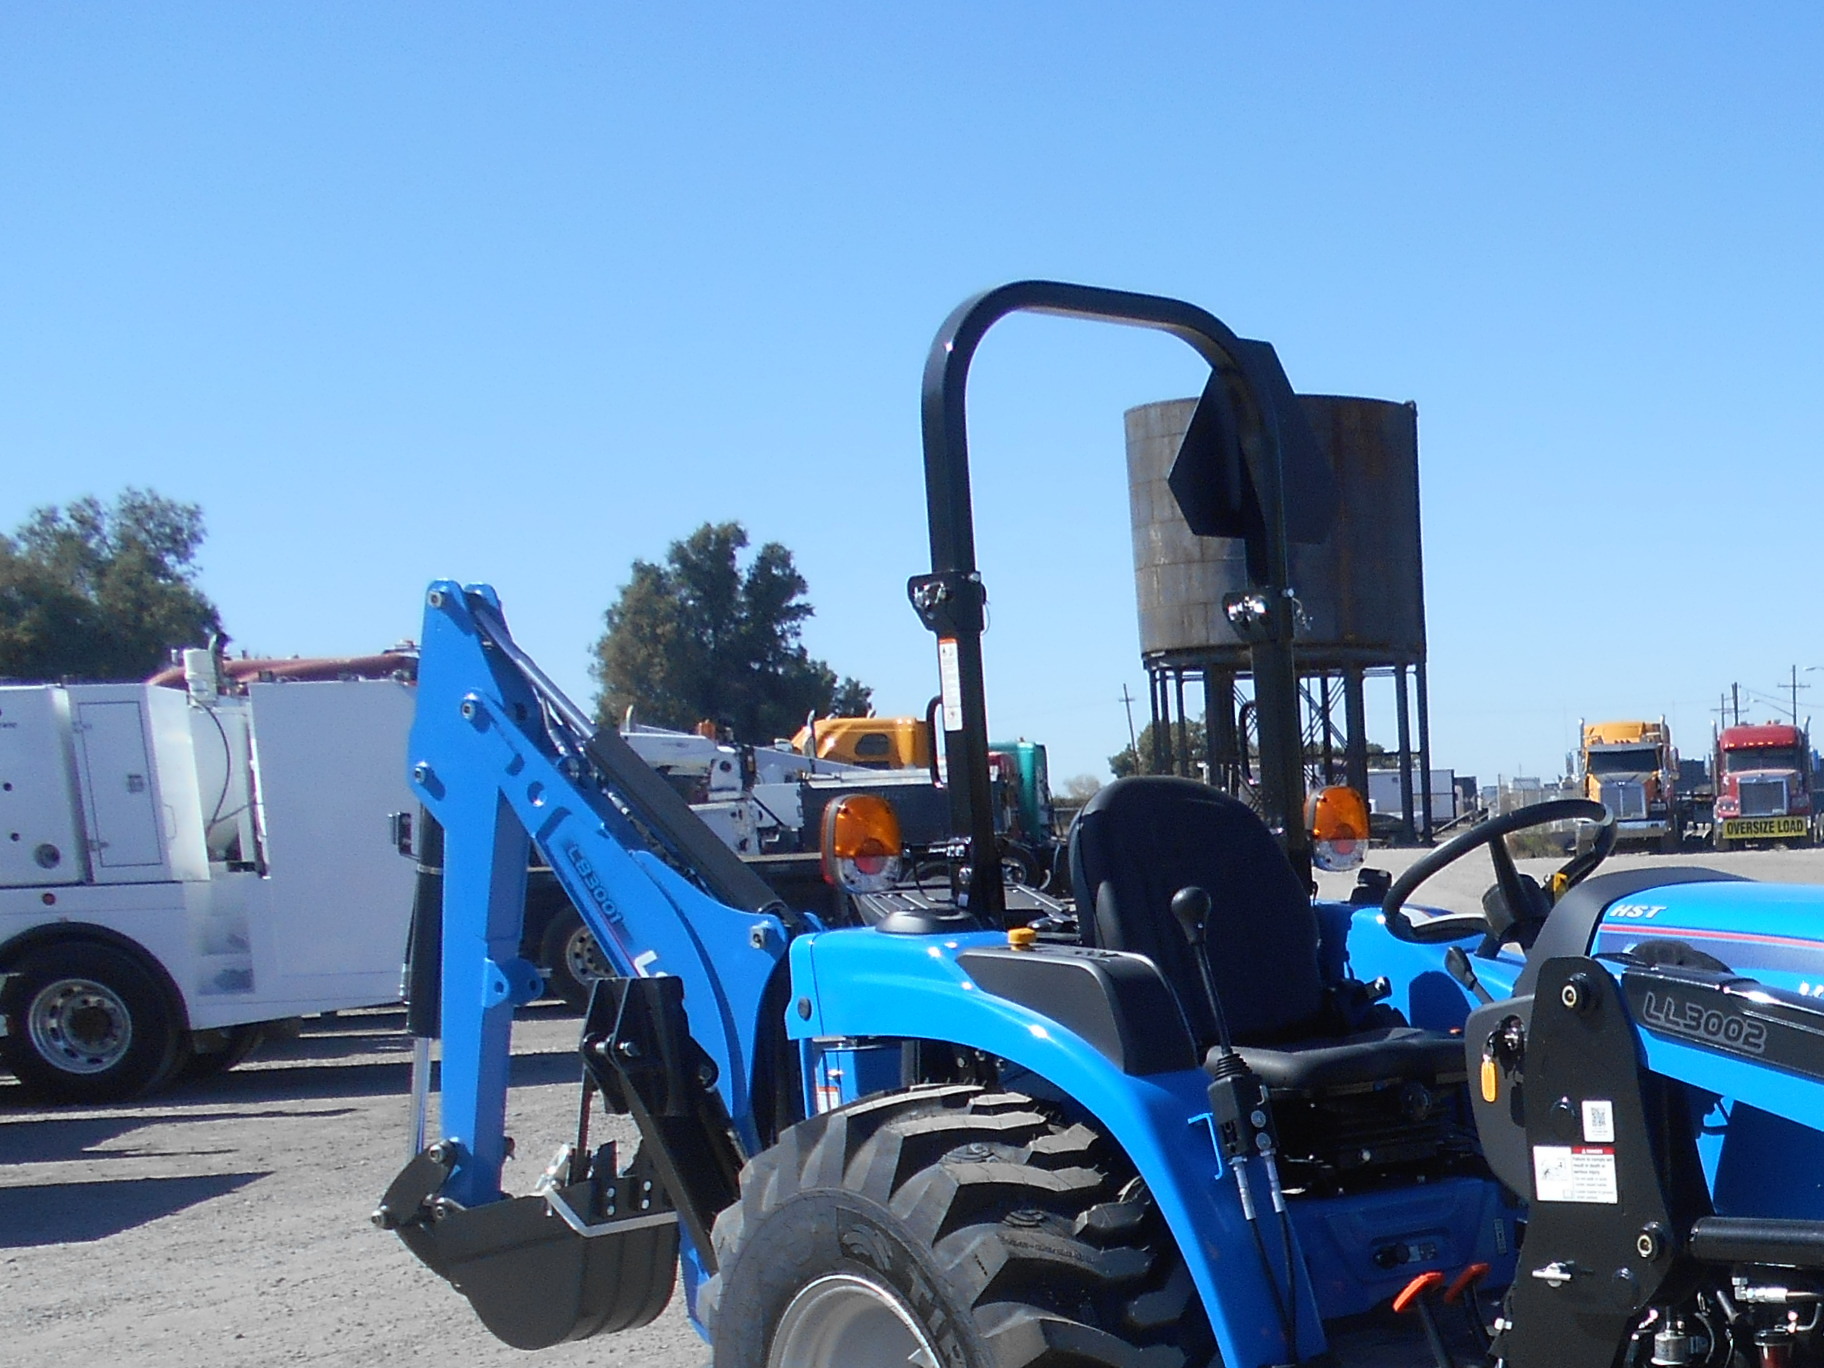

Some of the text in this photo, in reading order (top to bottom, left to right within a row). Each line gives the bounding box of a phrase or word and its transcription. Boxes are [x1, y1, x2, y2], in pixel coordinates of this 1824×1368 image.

[1727, 819, 1803, 835] OVERSIZE LOAD
[1609, 904, 1668, 919] HST
[634, 949, 668, 977] L
[1642, 991, 1767, 1054] LL3002
